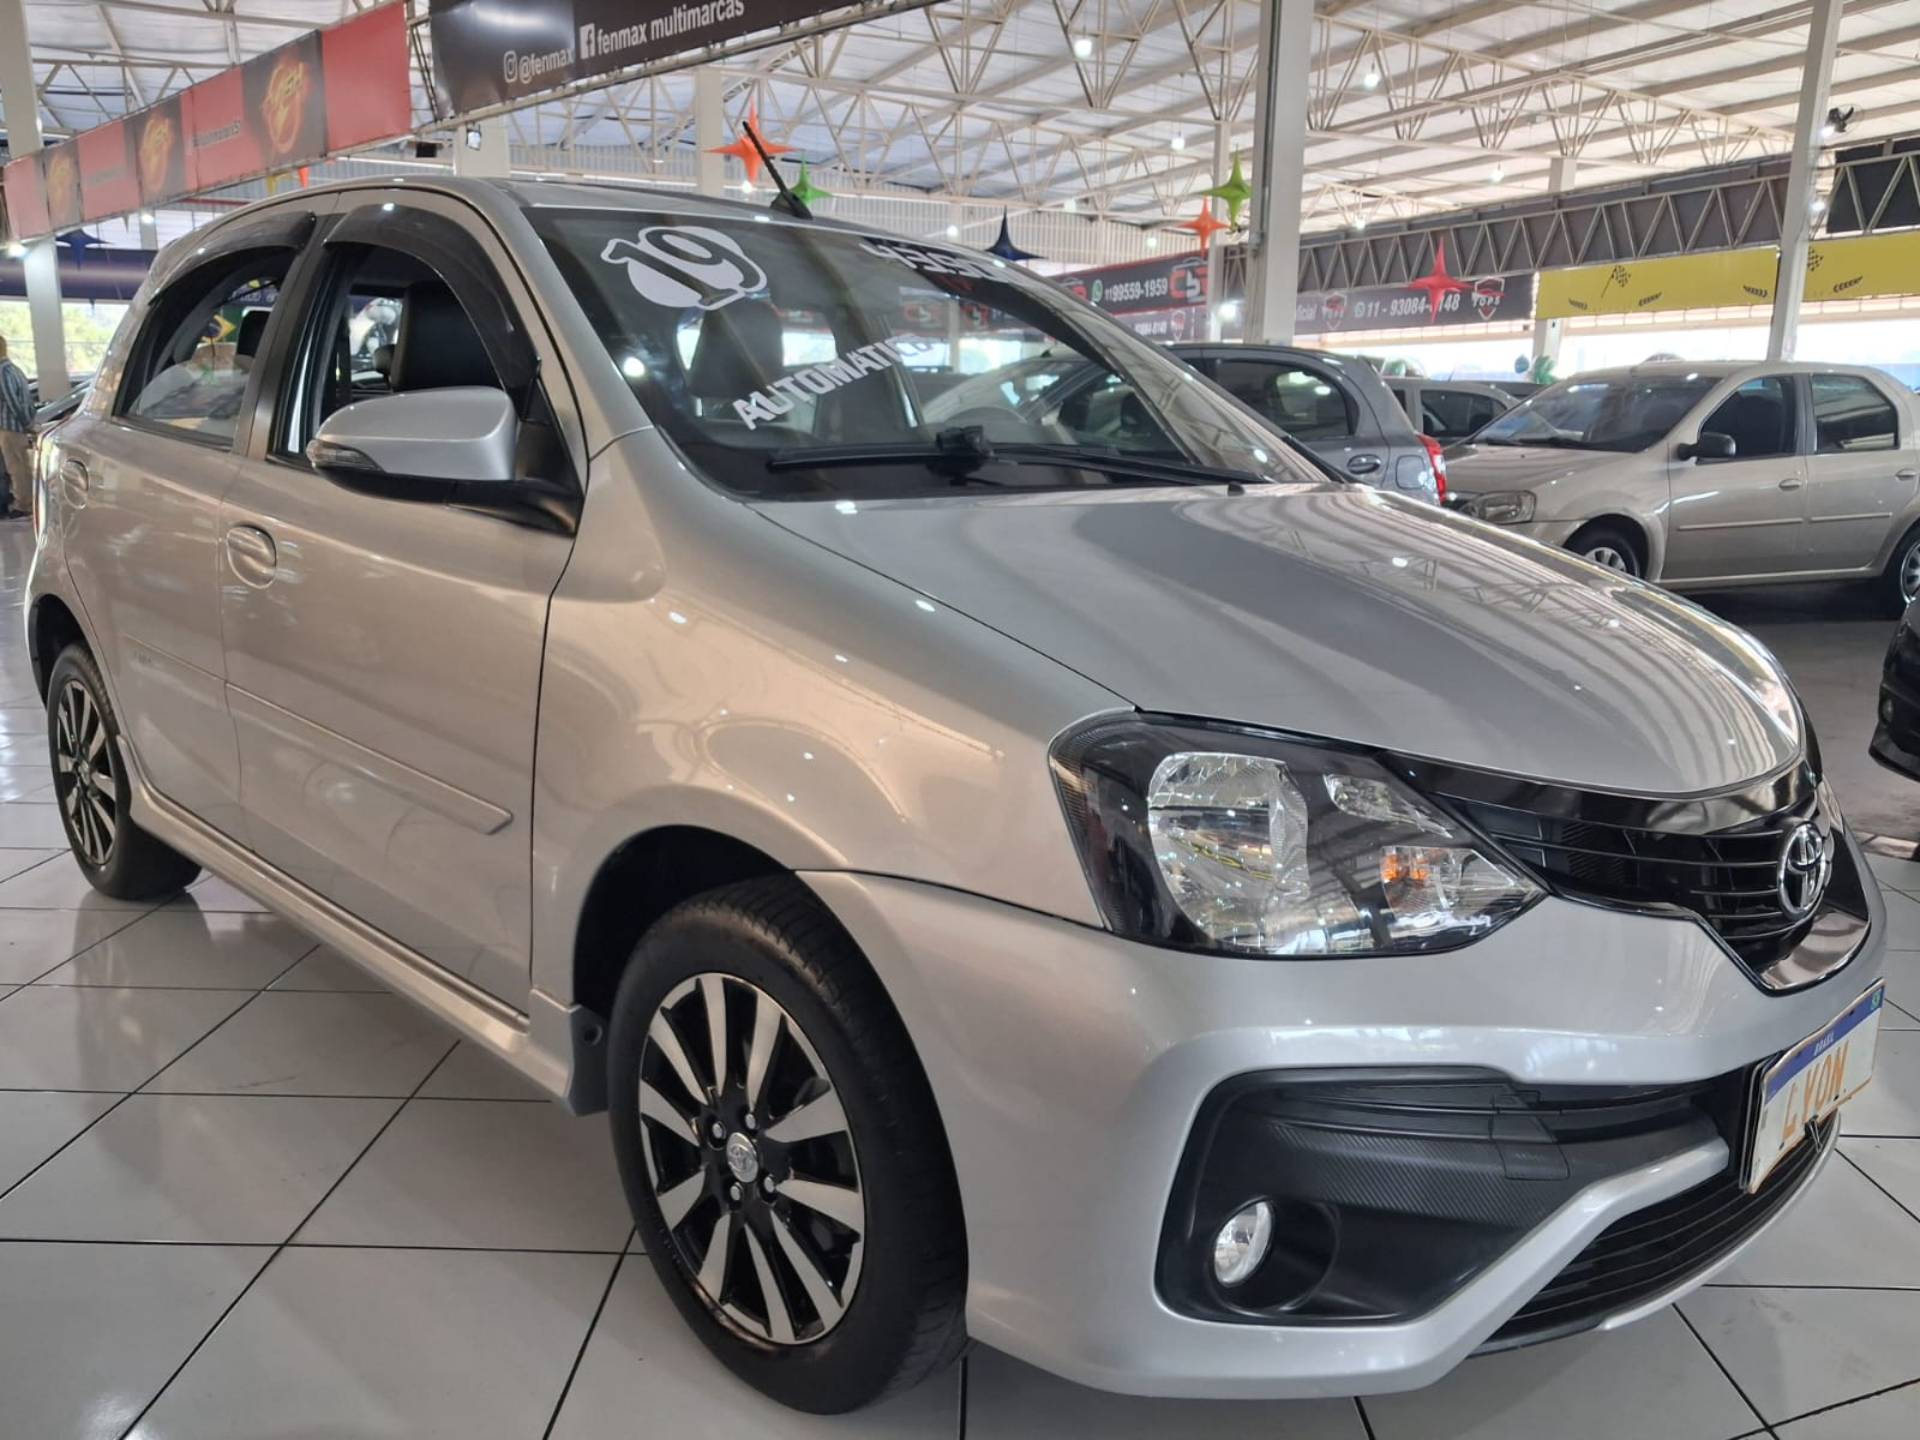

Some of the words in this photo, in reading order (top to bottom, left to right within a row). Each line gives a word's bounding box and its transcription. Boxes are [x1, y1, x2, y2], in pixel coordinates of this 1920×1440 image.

[597, 23, 648, 55] fenmax
[650, 0, 745, 41] multimarcas
[518, 48, 576, 84] @fenmax
[603, 227, 766, 309] 19
